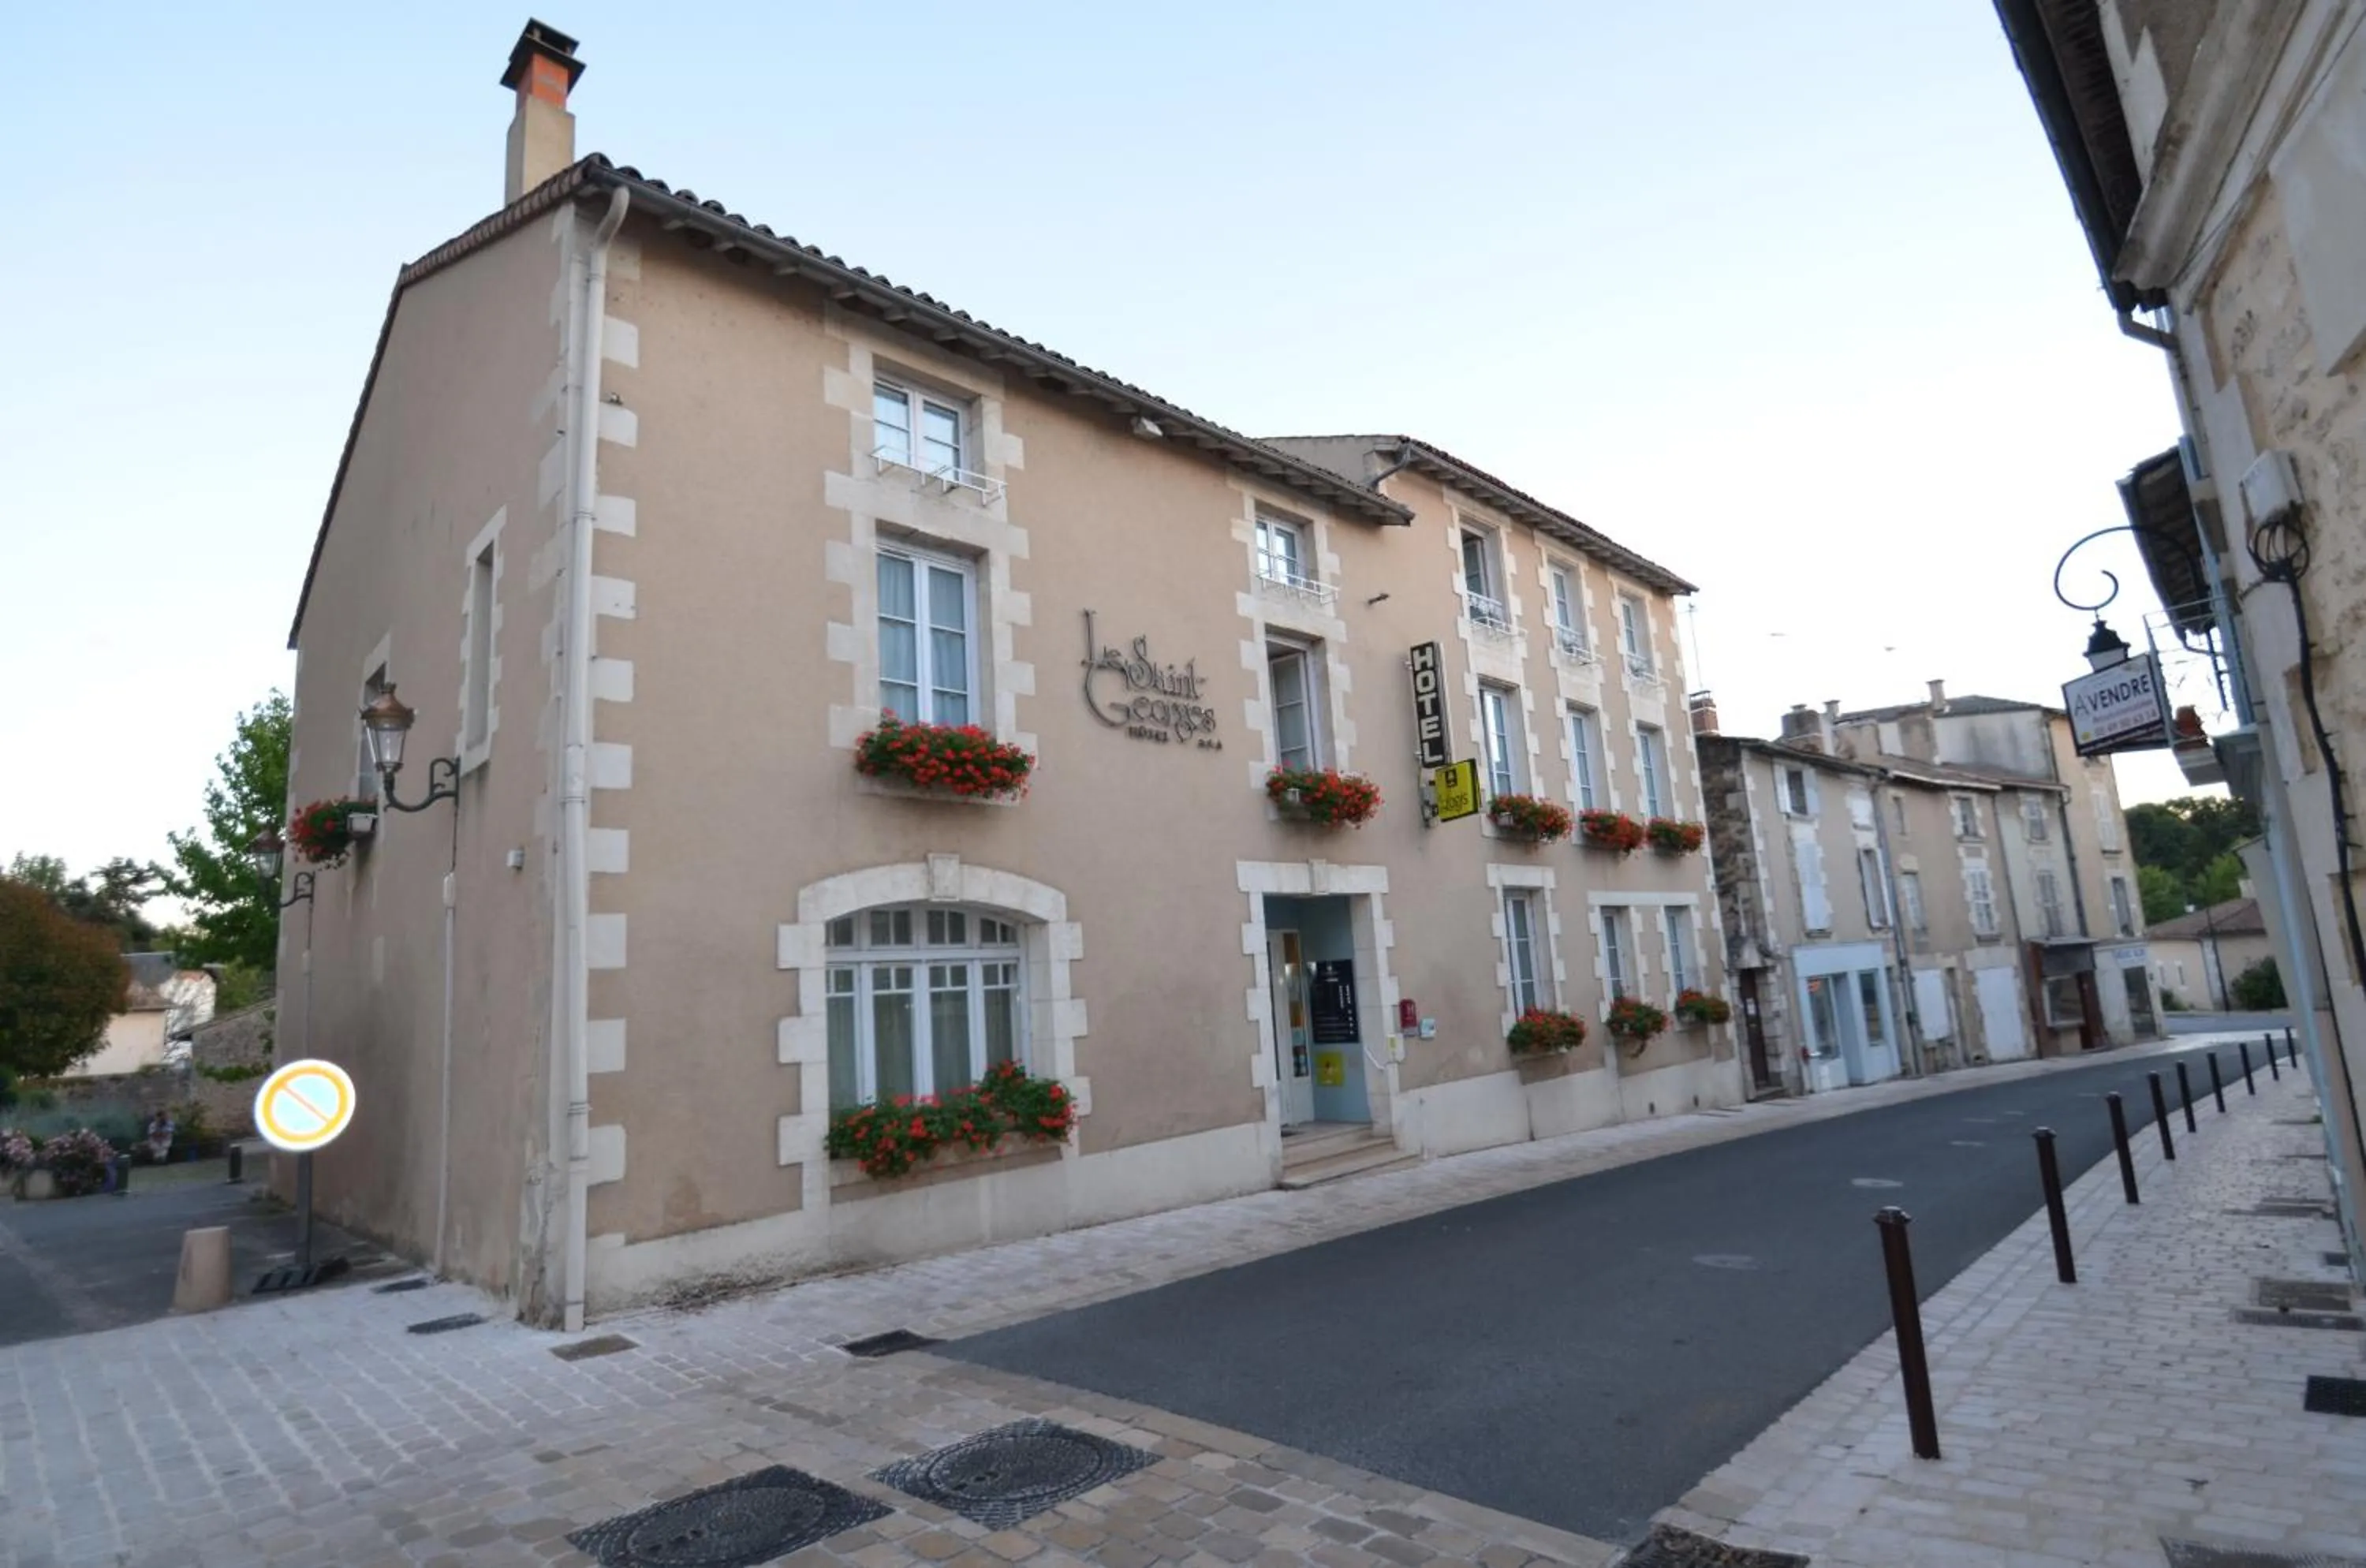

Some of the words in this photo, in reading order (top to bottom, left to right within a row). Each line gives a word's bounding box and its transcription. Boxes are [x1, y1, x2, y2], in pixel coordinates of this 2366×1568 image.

[1085, 663, 1215, 742] Georges
[1128, 634, 1208, 699] Saint
[2074, 693, 2090, 716] A
[2088, 674, 2150, 711] VENDRE
[1413, 646, 1443, 763] HOTEL
